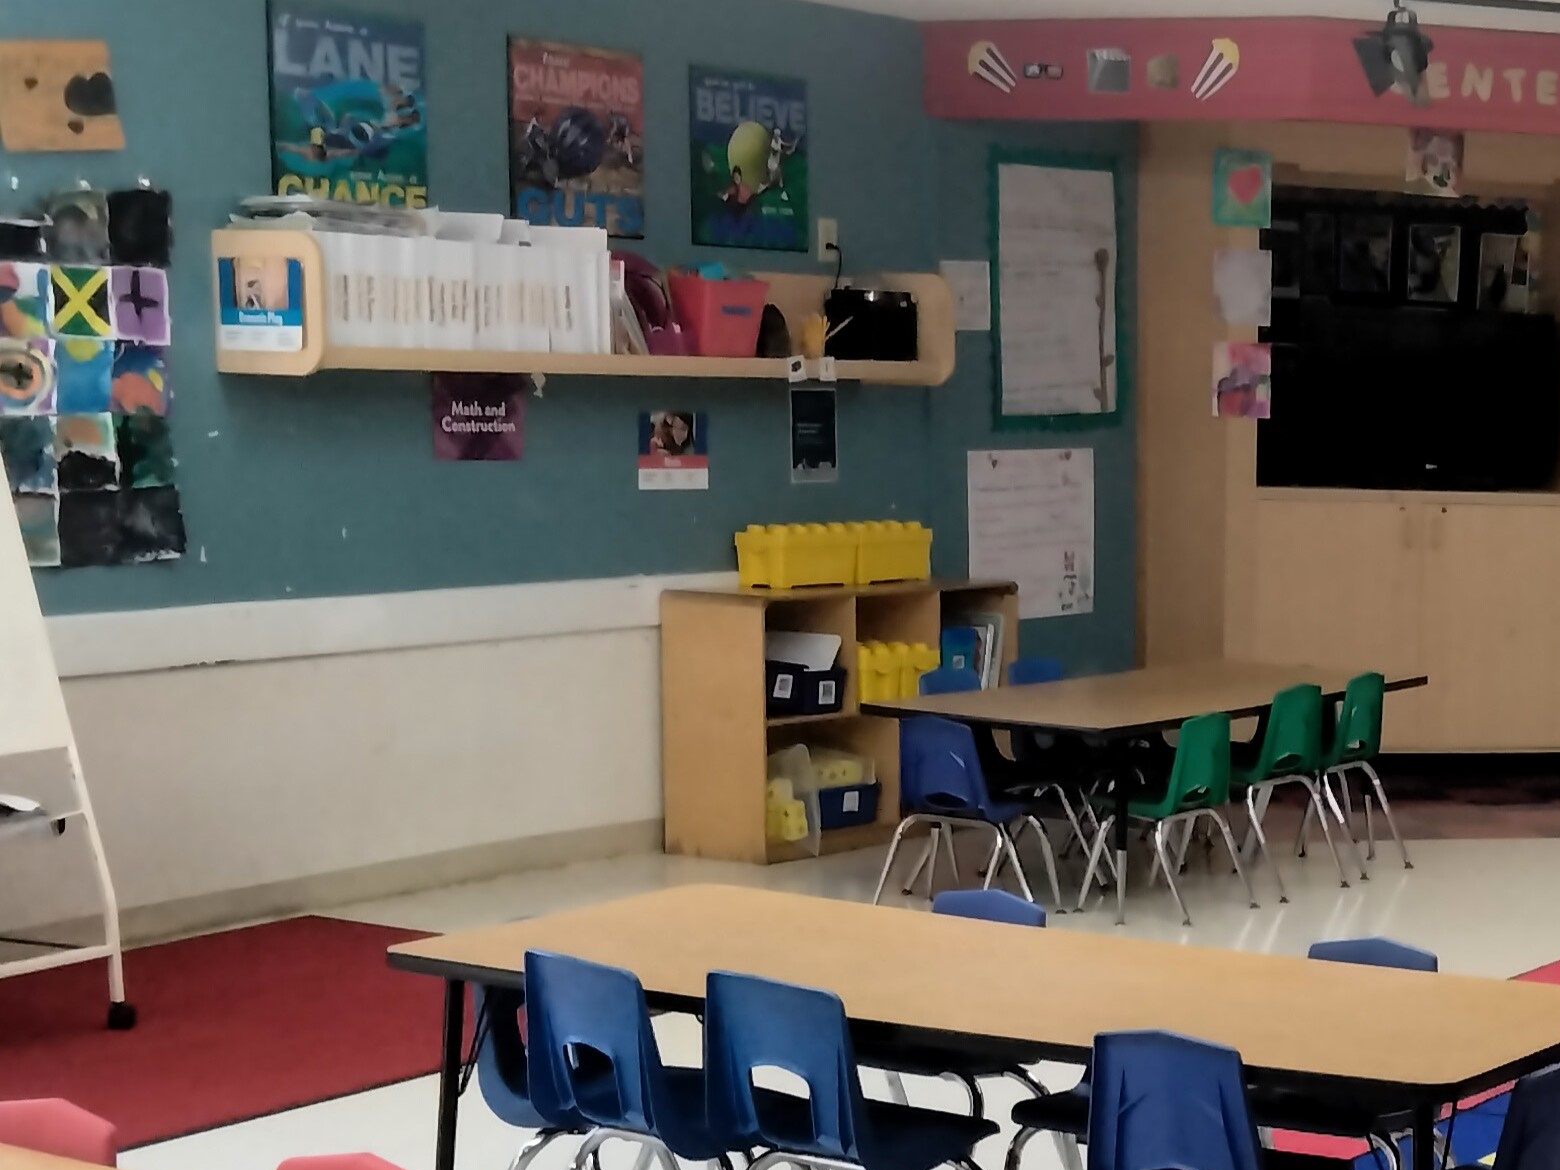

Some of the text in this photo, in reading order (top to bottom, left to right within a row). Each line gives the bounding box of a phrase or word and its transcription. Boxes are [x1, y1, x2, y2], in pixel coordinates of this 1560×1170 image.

[274, 28, 420, 90] LANE
[513, 64, 640, 104] CHAMPIONS
[696, 87, 806, 132] BELIEVE
[277, 173, 428, 209] CHANCE
[518, 187, 644, 233] GUTS
[441, 415, 516, 433] Construction
[451, 400, 506, 416] Math and
